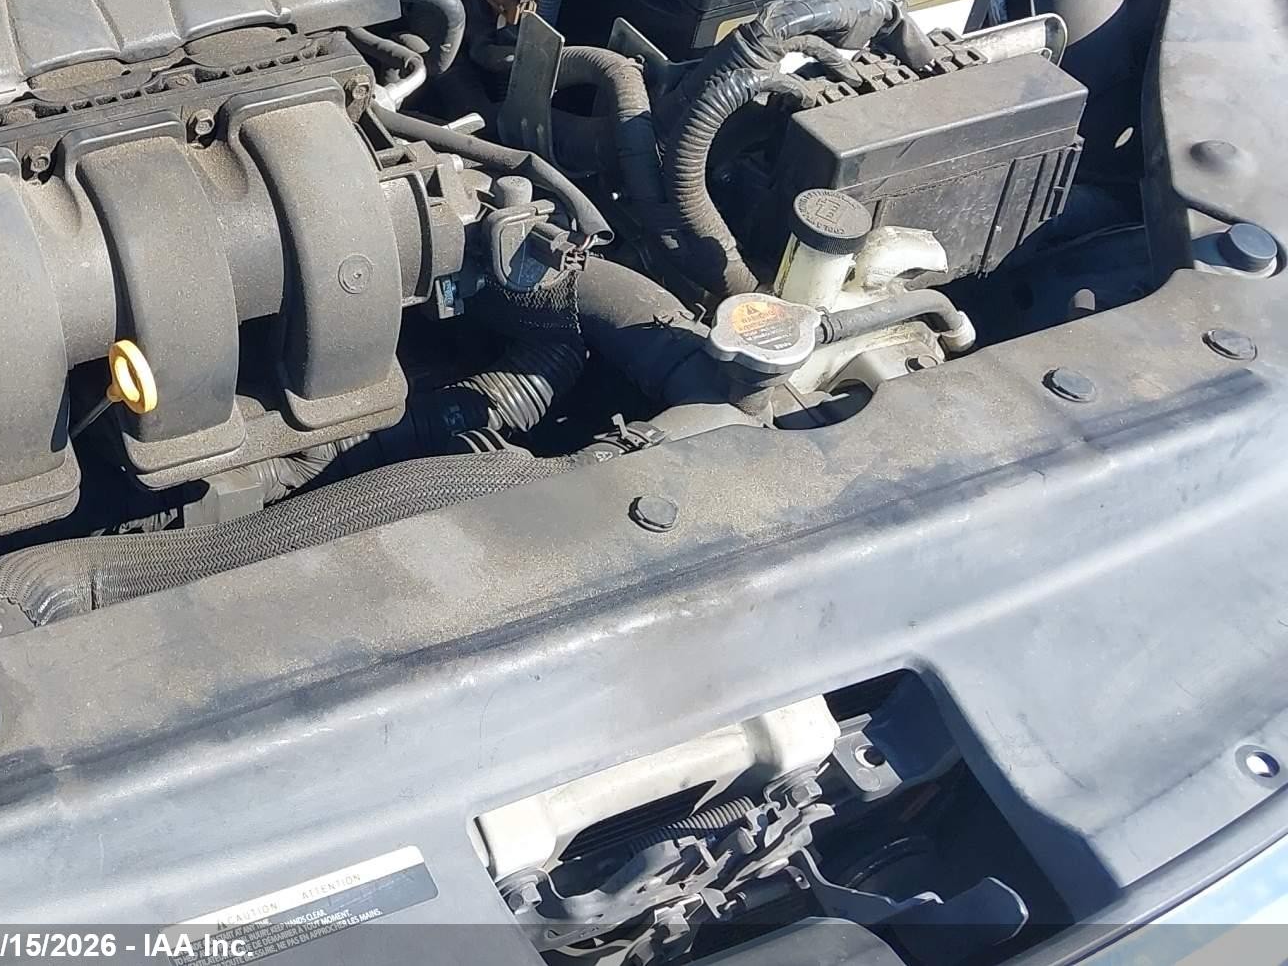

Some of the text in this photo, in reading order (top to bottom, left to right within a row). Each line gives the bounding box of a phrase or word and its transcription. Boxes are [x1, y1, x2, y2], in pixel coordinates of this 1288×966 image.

[228, 873, 361, 925] CAUTION ATTENTION
[242, 923, 256, 934] ANY
[284, 915, 307, 929] HANDS
[305, 908, 327, 922] CLEAR.
[302, 919, 320, 932] TOUT
[319, 908, 351, 926] MOMENT.
[243, 944, 278, 962] BSSURE,
[287, 936, 300, 947] PAS
[299, 932, 310, 943] EN
[346, 915, 359, 926] LES
[357, 907, 381, 922] MAINS.
